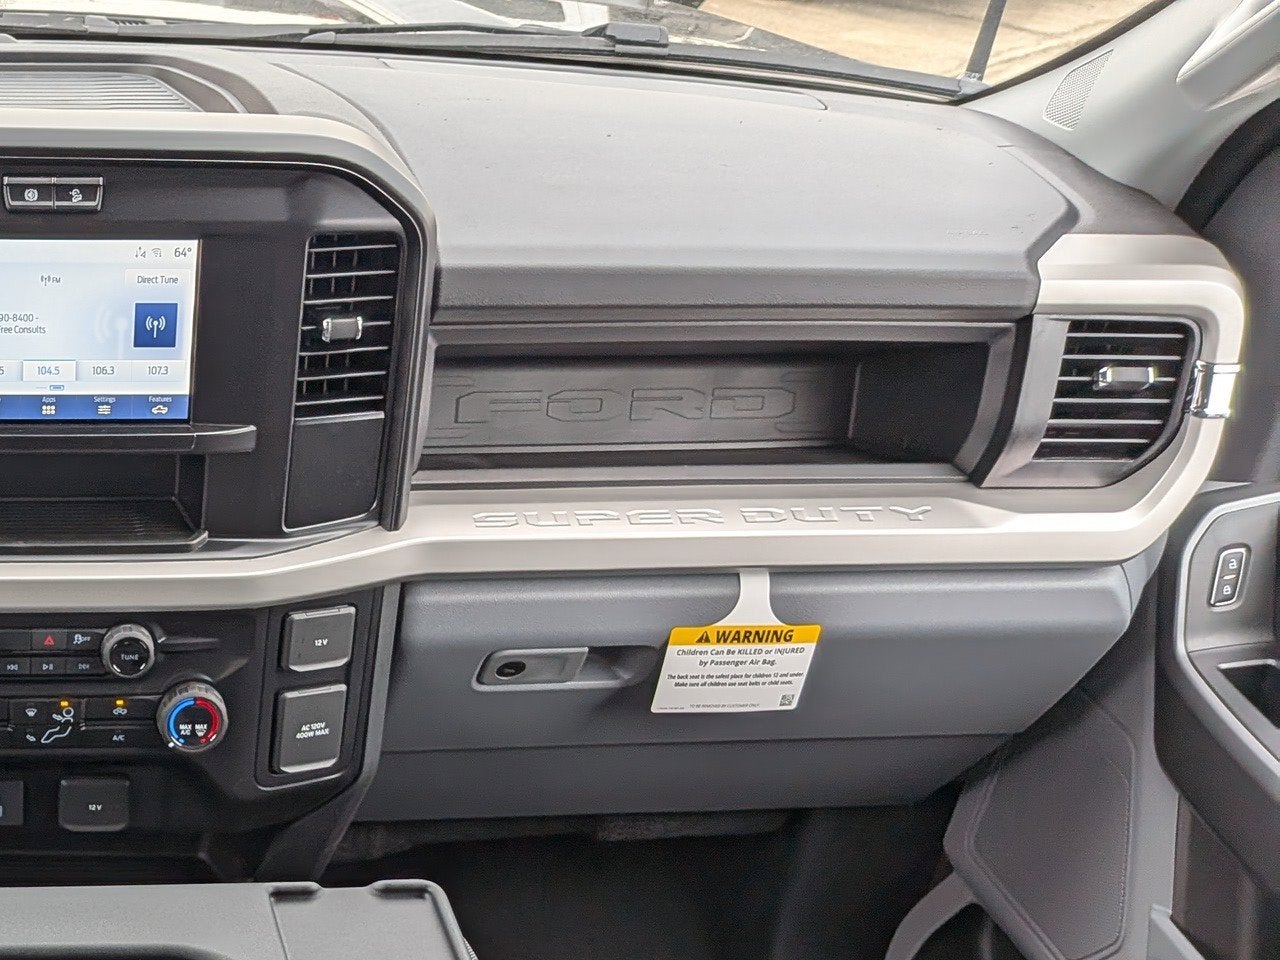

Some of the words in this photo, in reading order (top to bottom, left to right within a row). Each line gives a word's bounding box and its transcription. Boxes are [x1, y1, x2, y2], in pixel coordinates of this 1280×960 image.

[174, 247, 192, 258] 64°
[137, 275, 158, 284] Direct
[160, 276, 179, 284] Tune
[13, 325, 46, 334] Consults
[37, 366, 60, 375] 104.5
[92, 366, 115, 375] 106.3
[147, 366, 169, 375] 107.3
[41, 396, 56, 404] Apps
[93, 396, 116, 404] Settings
[454, 387, 797, 424] FORD
[471, 508, 724, 528] SUPER
[738, 505, 932, 524] DUTY
[715, 629, 794, 644] WARNING
[774, 647, 805, 655] INJURED
[121, 653, 139, 661] TUNE
[709, 659, 748, 667] Passenger
[315, 728, 329, 736] MAX
[112, 734, 125, 742] A/C
